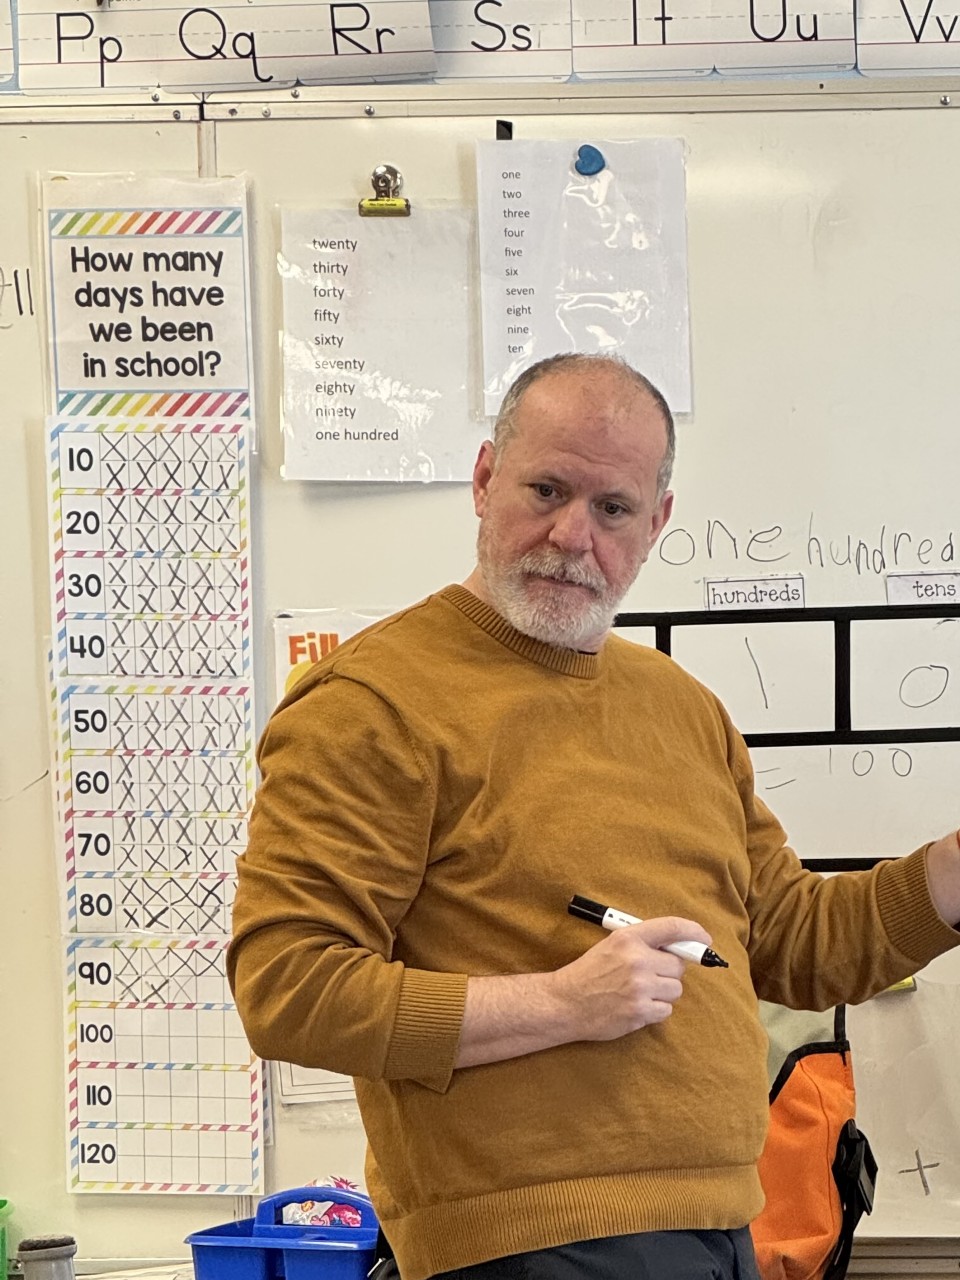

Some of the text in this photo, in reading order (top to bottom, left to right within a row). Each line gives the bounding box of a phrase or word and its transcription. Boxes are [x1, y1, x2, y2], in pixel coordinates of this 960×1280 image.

[56, 12, 123, 88] Pp
[178, 8, 274, 82] Qq
[329, 3, 396, 55] Rr
[470, 0, 533, 52] Ss
[749, 0, 819, 43] Uu
[900, 0, 958, 44] Vv
[501, 171, 521, 180] one
[502, 190, 522, 199] two
[503, 208, 531, 218] three
[503, 228, 525, 238] four
[312, 238, 358, 252] twenty
[504, 247, 523, 257] five
[70, 245, 224, 278] How many
[312, 262, 349, 276] thirty
[505, 267, 519, 276] six
[74, 280, 225, 314] days have
[313, 286, 345, 301] forty
[505, 287, 535, 296] seven
[313, 309, 340, 324] fifty
[506, 306, 532, 317] eight
[88, 315, 214, 343] we been
[507, 325, 529, 334] nine
[314, 334, 344, 348] sixty
[508, 345, 525, 354] ten
[82, 350, 222, 378] in school?
[315, 358, 366, 372] seventy
[315, 382, 356, 396] eighty
[315, 405, 357, 420] ninety
[315, 429, 399, 441] one hundred
[67, 447, 94, 471] 10
[65, 511, 101, 535] 20
[659, 512, 956, 575] one hundred
[67, 573, 102, 598] 30
[711, 584, 802, 606] hundreds
[912, 580, 957, 599] tens
[68, 634, 106, 658] 40
[73, 709, 108, 733] 50
[75, 770, 110, 795] 60
[77, 832, 111, 857] 70
[78, 892, 114, 917] 80
[78, 961, 112, 986] 90
[79, 1023, 114, 1044] 100
[86, 1085, 113, 1107] 110
[79, 1142, 117, 1164] 120
